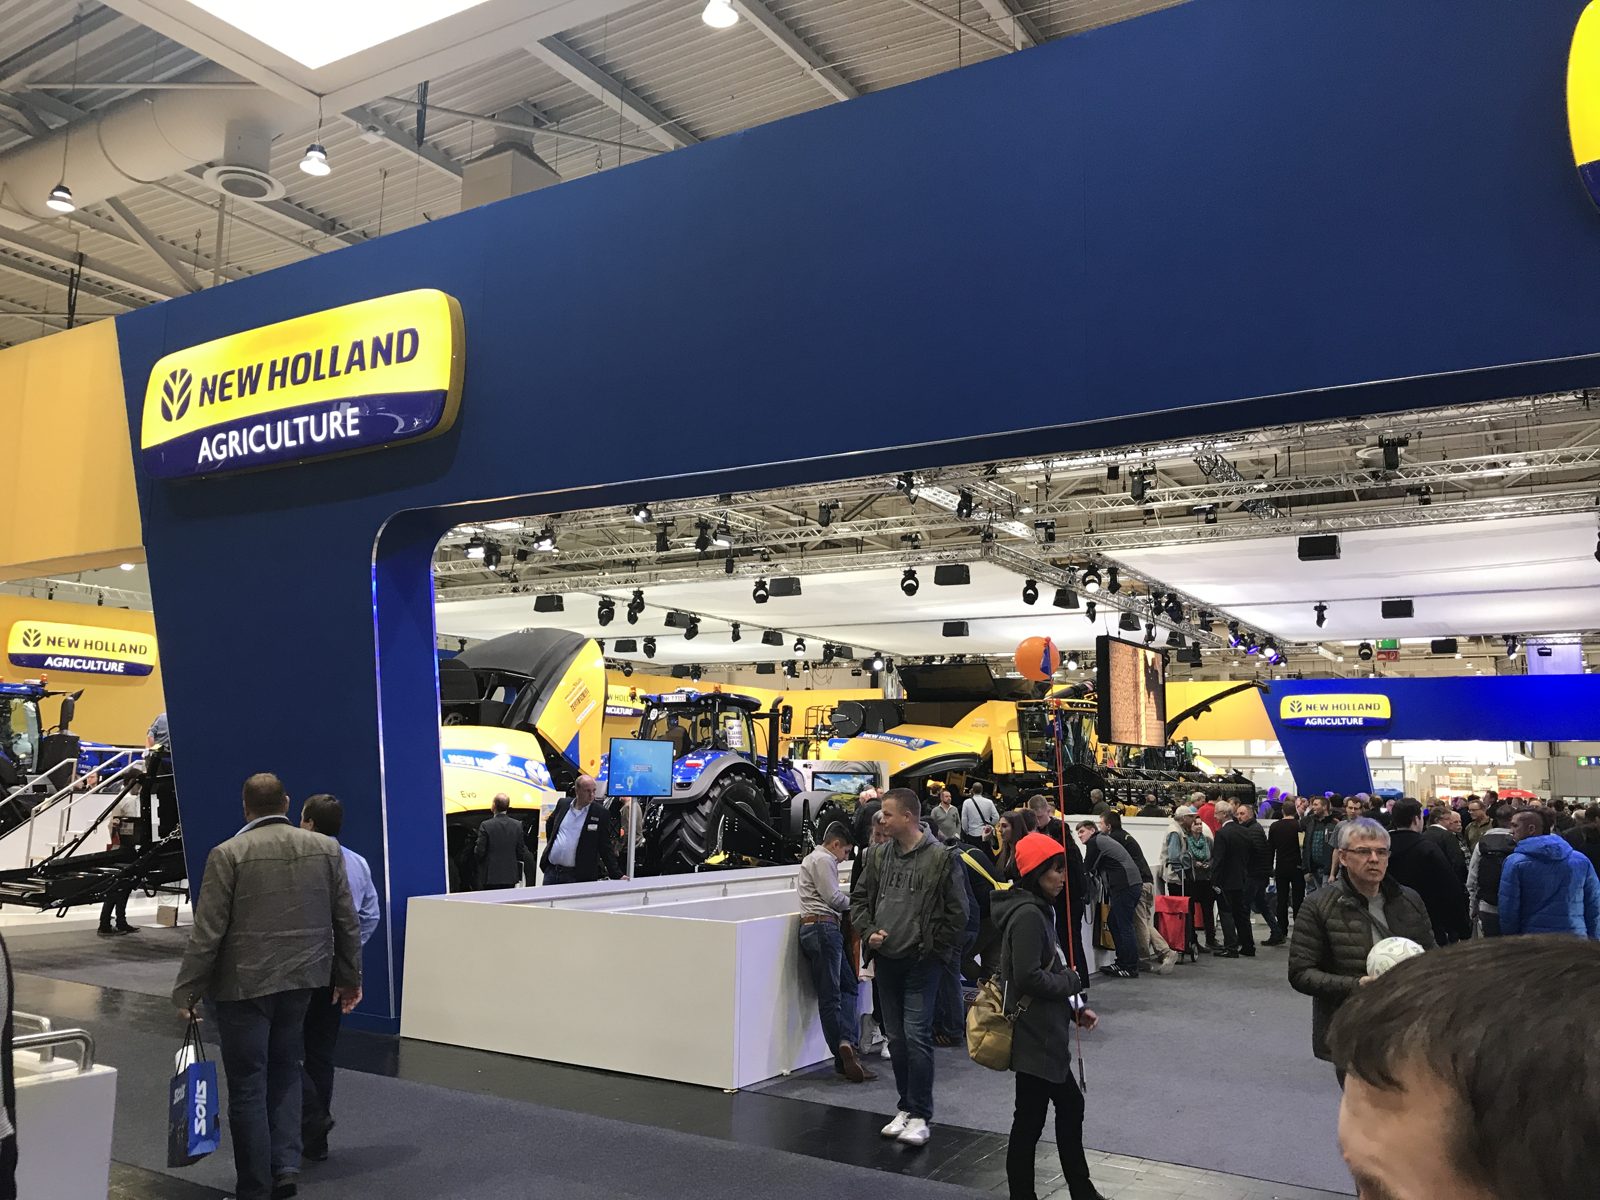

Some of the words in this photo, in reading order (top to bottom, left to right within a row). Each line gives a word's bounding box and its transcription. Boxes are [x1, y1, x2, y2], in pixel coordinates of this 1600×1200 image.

[199, 363, 263, 407] NEW
[268, 328, 419, 391] HOLLAND
[198, 407, 360, 463] AGRICULTURE
[47, 636, 80, 648] NEW
[84, 639, 148, 655] HOLLAND
[44, 656, 125, 673] AGRICULTURE
[1305, 703, 1329, 711] NEW
[1332, 702, 1381, 711] HOLLAND
[1304, 717, 1364, 726] AGRICULTURE
[879, 734, 907, 745] HOLLAND
